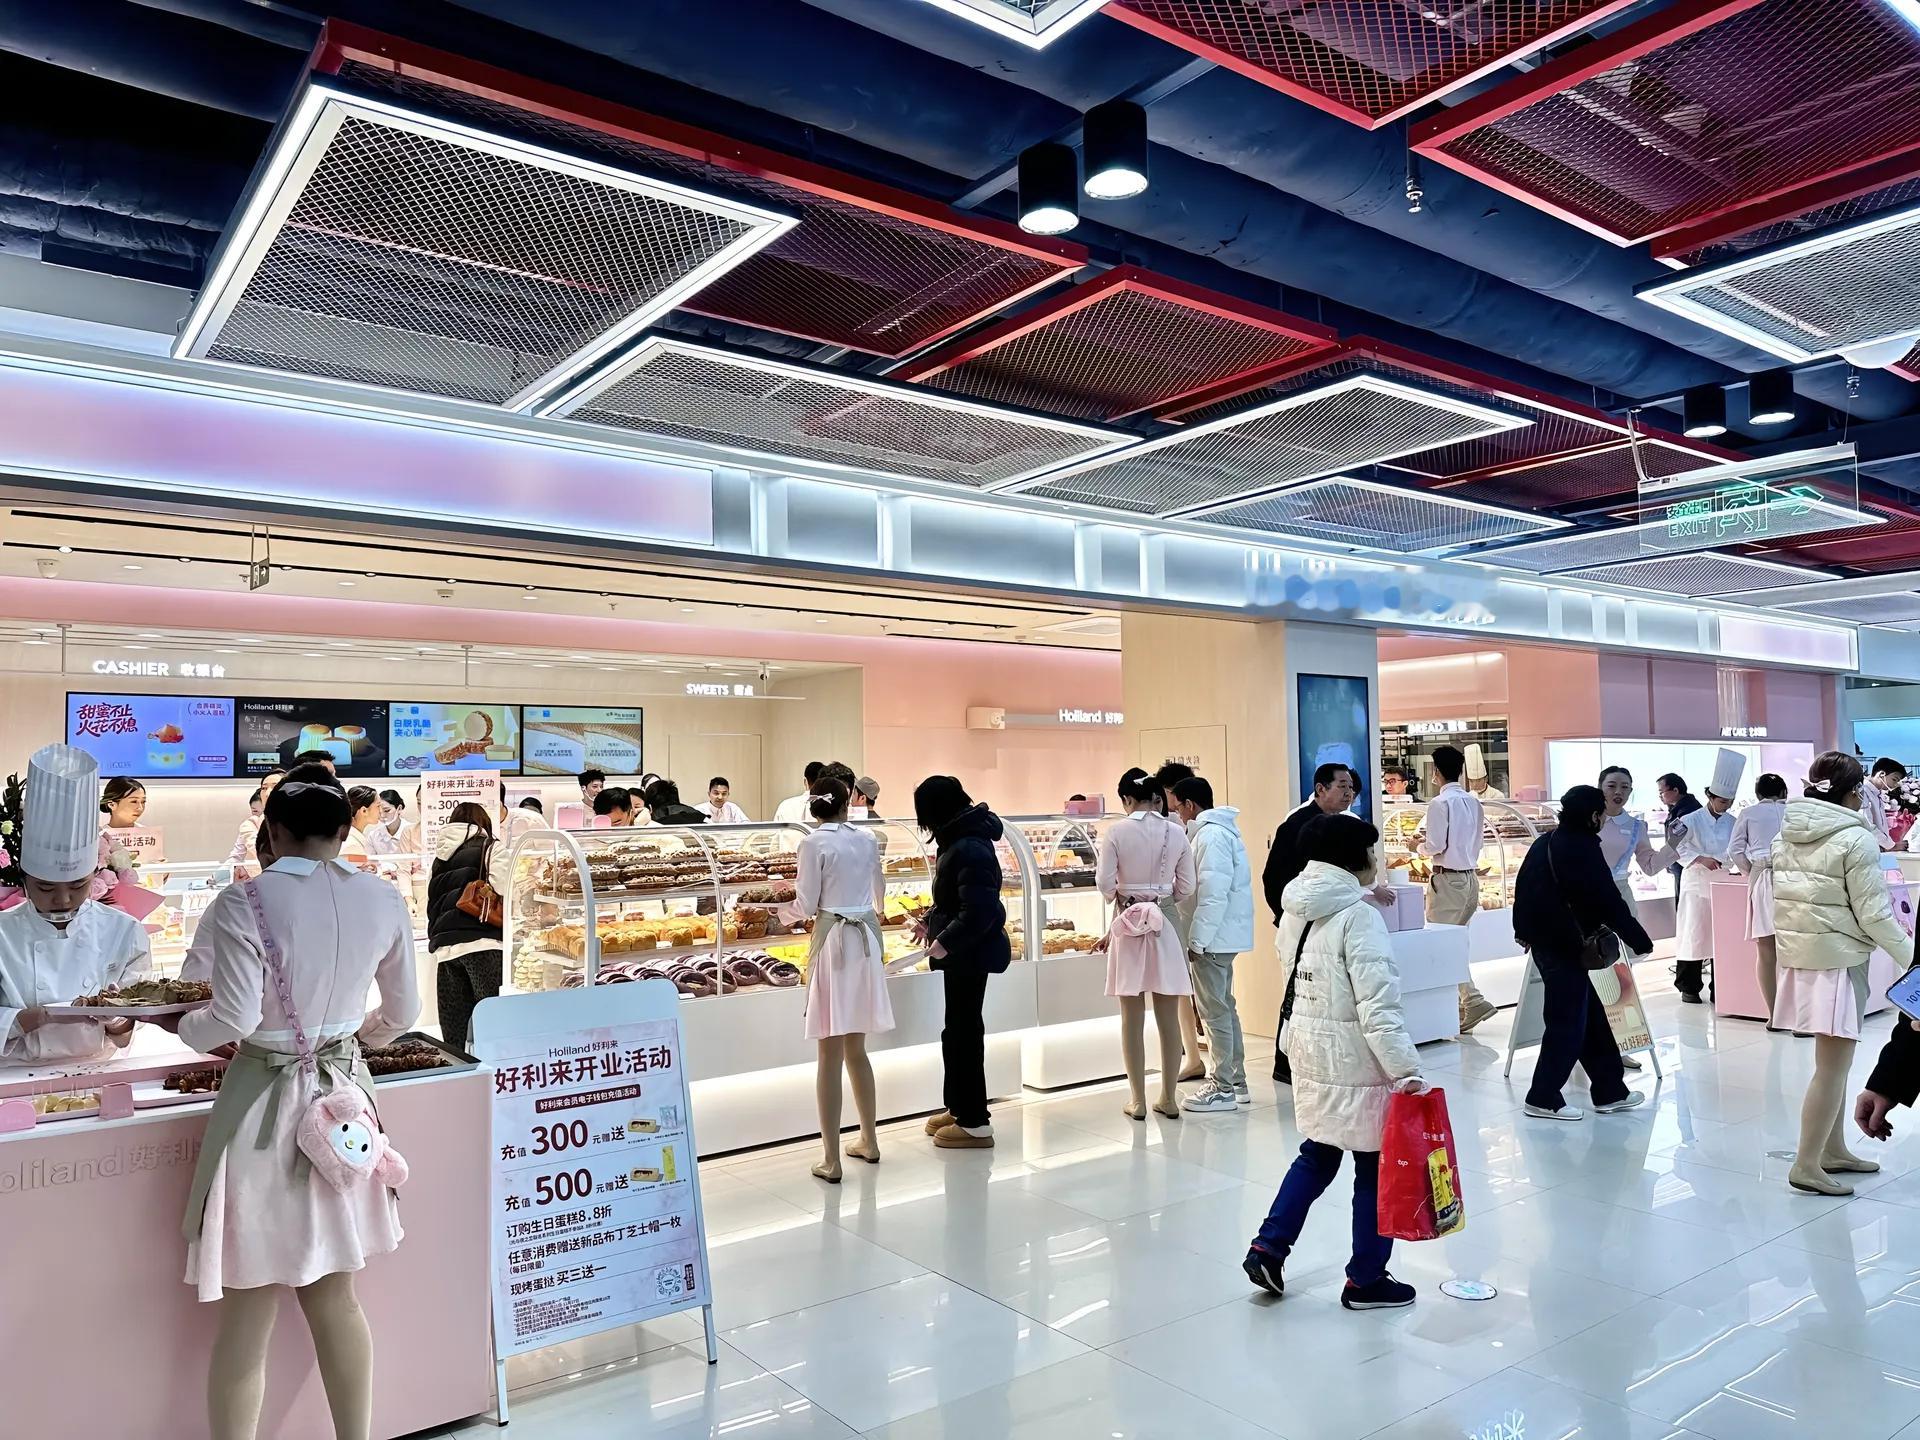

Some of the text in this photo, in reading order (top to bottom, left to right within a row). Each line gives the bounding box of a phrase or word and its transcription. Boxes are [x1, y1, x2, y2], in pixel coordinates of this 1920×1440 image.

[1667, 500, 1711, 519] 安全出口
[1669, 519, 1711, 537] EXIT
[92, 660, 170, 677] CASHIER
[686, 683, 729, 696] SWEETS
[76, 702, 133, 720] 甜蜜不止
[244, 703, 274, 711] Holiland
[1059, 709, 1101, 723] Holiland
[75, 716, 138, 737] 火花不熄
[426, 778, 495, 789] 好利来开业活动
[549, 1040, 619, 1058] Holiland 好利来
[495, 1045, 672, 1094] 好利来开业活动
[540, 1087, 637, 1110] 好利来会员电子钱包充值活动
[506, 1205, 612, 1239] 订购生日蛋糕8.8折
[508, 1215, 682, 1265] 任意消费赠送新品布丁芝士帽一枚
[510, 1264, 607, 1296] 现烤蛋挞 买三送一
